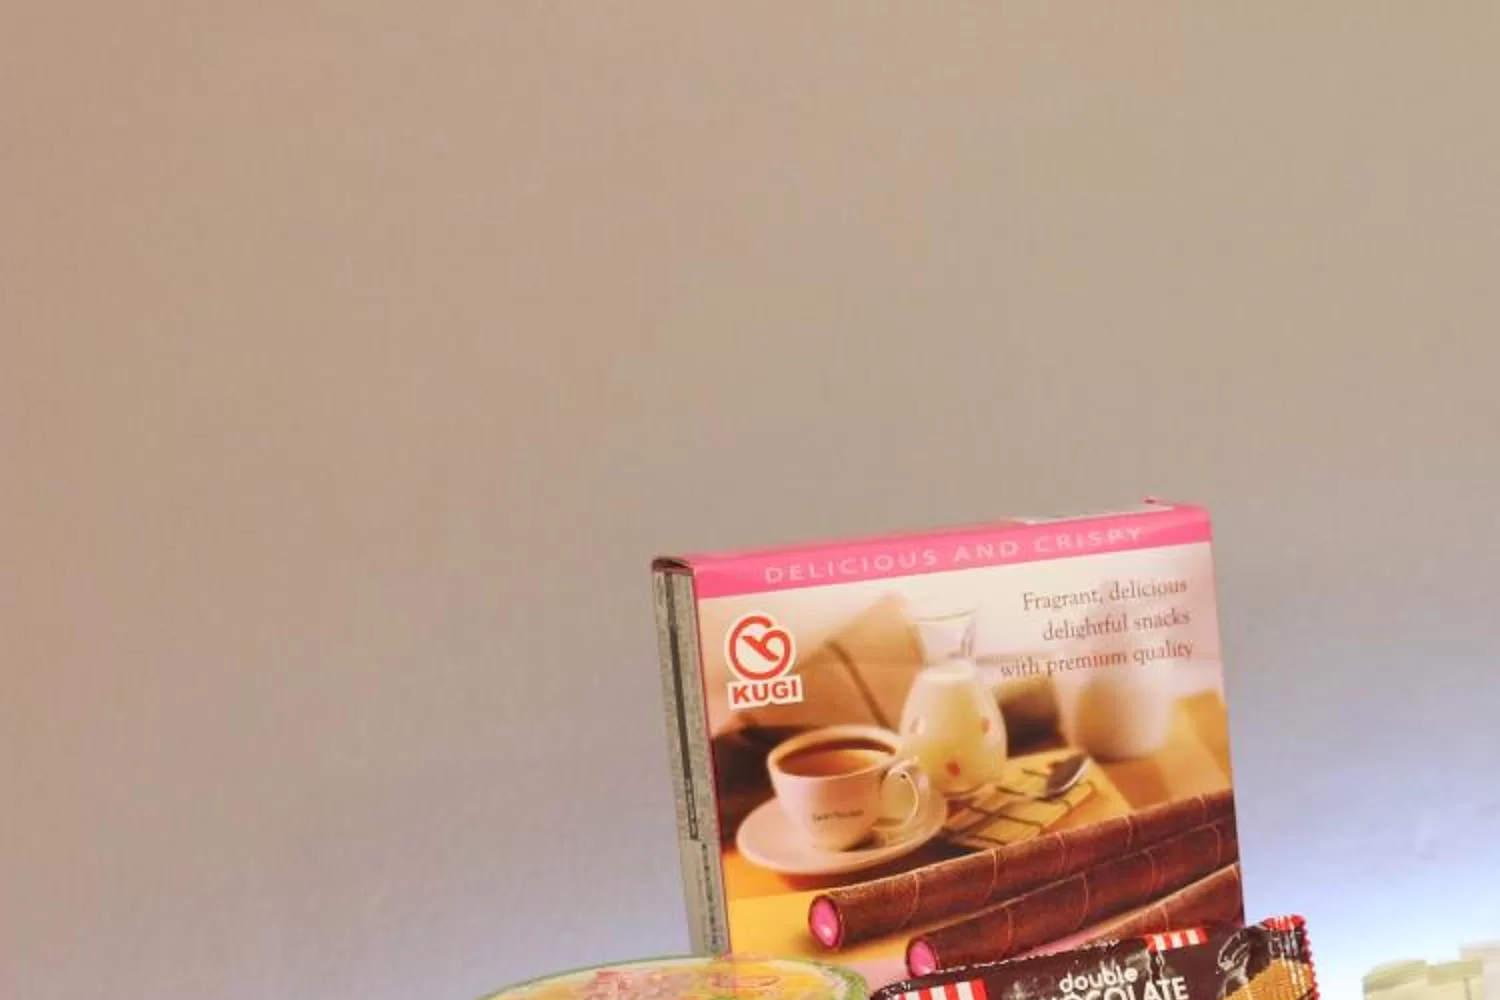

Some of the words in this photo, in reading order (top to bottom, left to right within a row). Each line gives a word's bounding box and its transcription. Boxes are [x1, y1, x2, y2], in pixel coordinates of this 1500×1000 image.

[764, 550, 938, 585] DELICIOUS
[954, 540, 1018, 564] AND
[1034, 526, 1142, 554] CRISPY
[1109, 578, 1187, 602] delicious
[1042, 612, 1128, 642] delightful
[1134, 607, 1192, 630] snacks
[1000, 656, 1040, 679] with
[1046, 650, 1127, 678] premium
[1133, 640, 1193, 666] quality
[732, 680, 799, 704] KUGI
[1060, 964, 1139, 993] double
